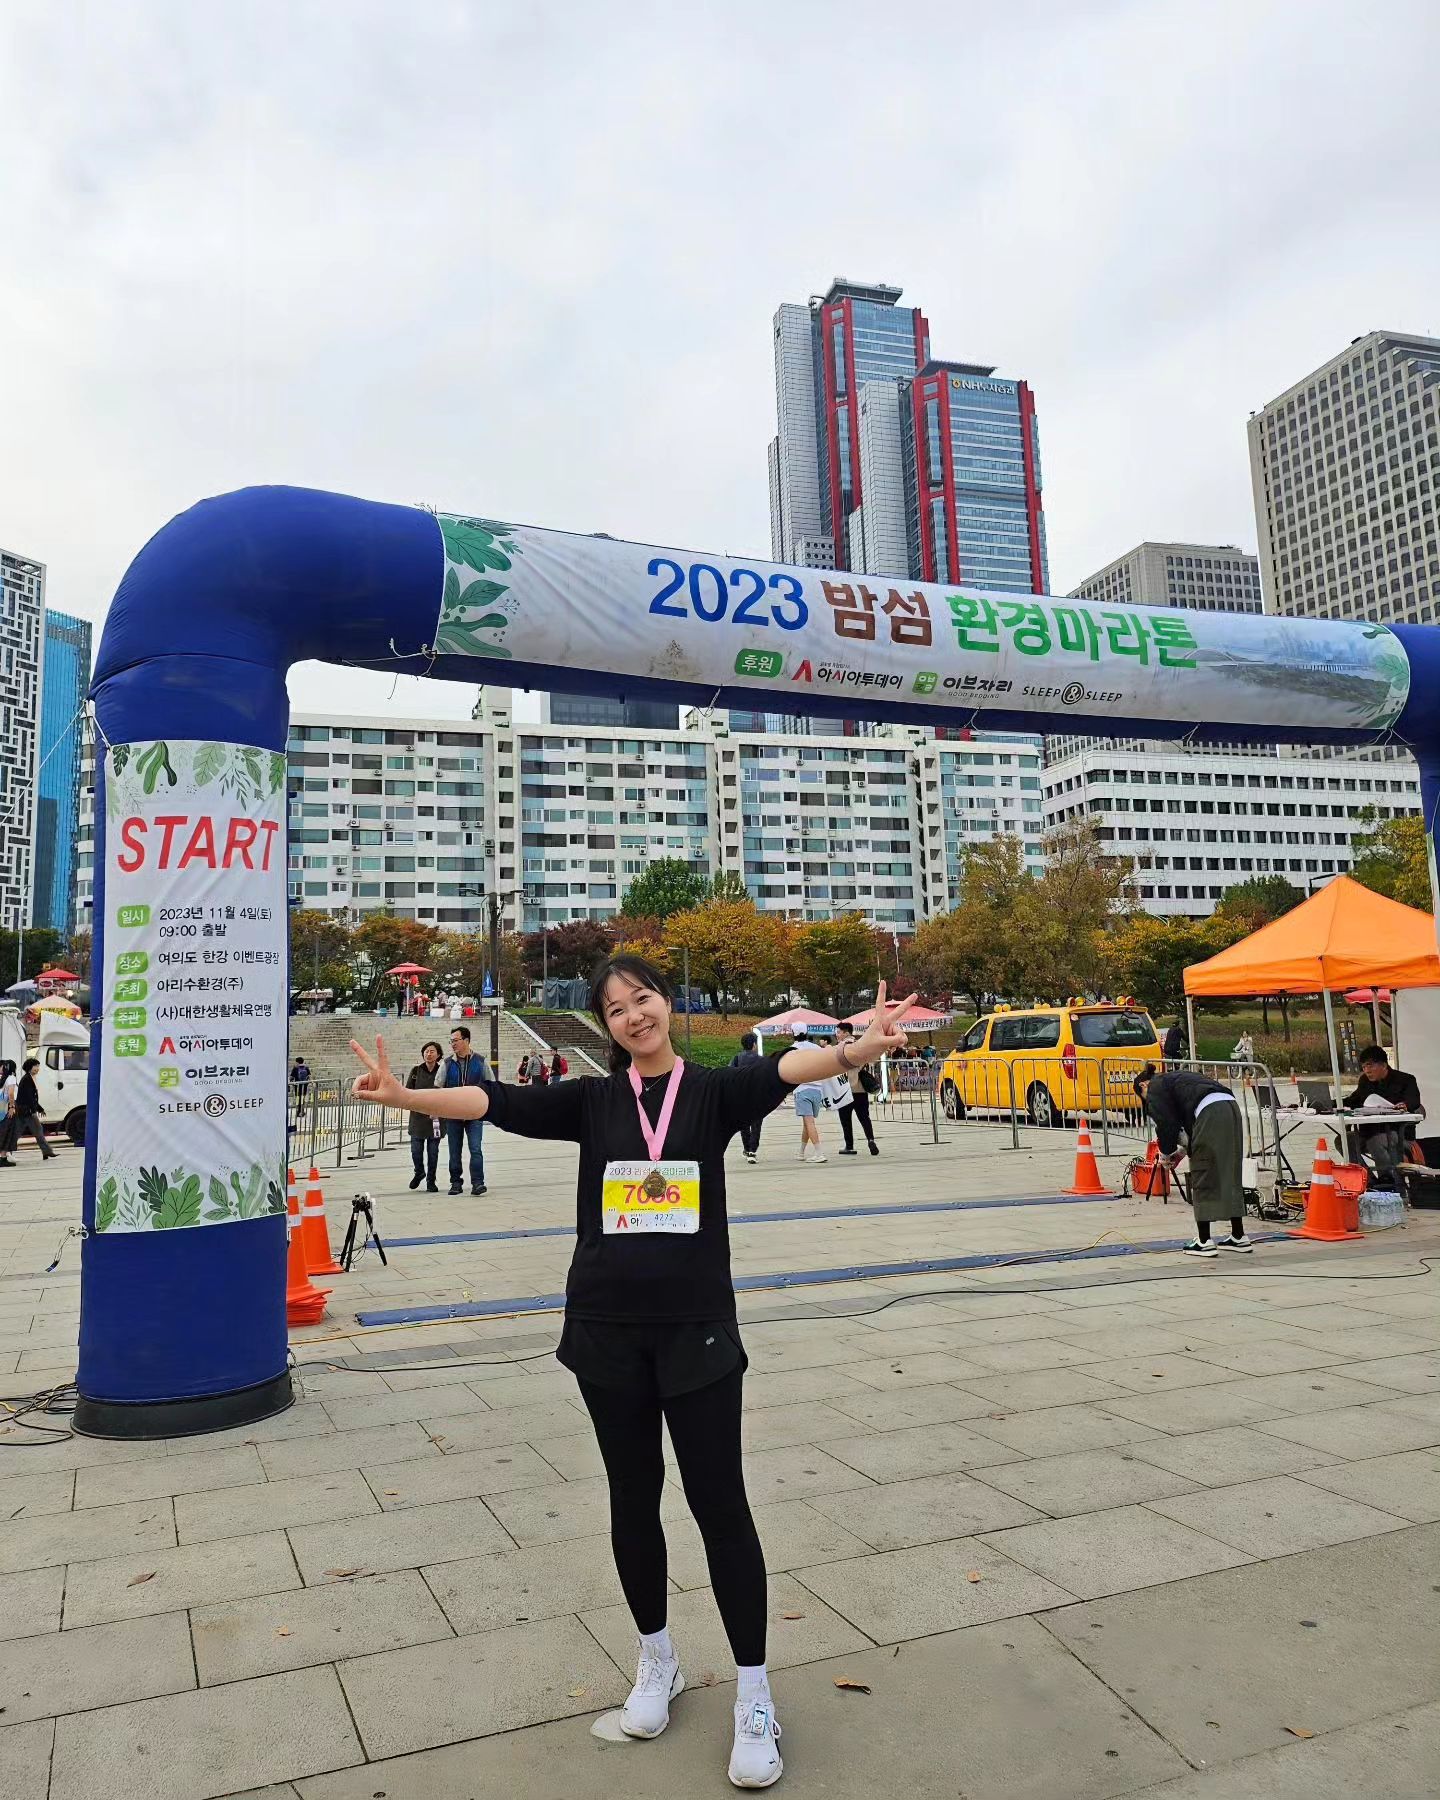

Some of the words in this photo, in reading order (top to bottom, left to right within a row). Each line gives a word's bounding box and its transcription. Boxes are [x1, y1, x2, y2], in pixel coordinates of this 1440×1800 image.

[647, 558, 809, 631] 2023
[820, 580, 932, 646] 밤섬
[945, 594, 1198, 668] 환경마라톤
[742, 654, 774, 673] 후원
[817, 667, 904, 689] 아시아투데이
[943, 675, 1013, 692] 이브자리
[1022, 686, 1062, 698] SLEEP
[1084, 690, 1123, 702] SLEEP
[117, 815, 279, 872] START
[121, 910, 144, 924] 일시
[159, 906, 204, 921] 2023년
[209, 905, 236, 920] 11월
[240, 908, 273, 921] 4일(토)
[159, 925, 197, 938] 09:00
[201, 923, 228, 937] 출발
[119, 956, 142, 970] 장소
[158, 951, 198, 965] 여의도
[202, 950, 229, 964] 한강
[233, 951, 280, 965] 이벤트광장
[119, 984, 141, 997] 주최
[157, 977, 244, 993] 아리수환경(주)
[118, 1011, 140, 1025] 주관
[156, 1003, 273, 1021] (사)대한생활체육연맹
[118, 1039, 141, 1053] 후원
[179, 1037, 253, 1052] 아시아투데이
[185, 1065, 250, 1079] 이브자리
[159, 1103, 201, 1114] SLEEP
[229, 1098, 264, 1109] SLEEP
[609, 1167, 632, 1176] 2023
